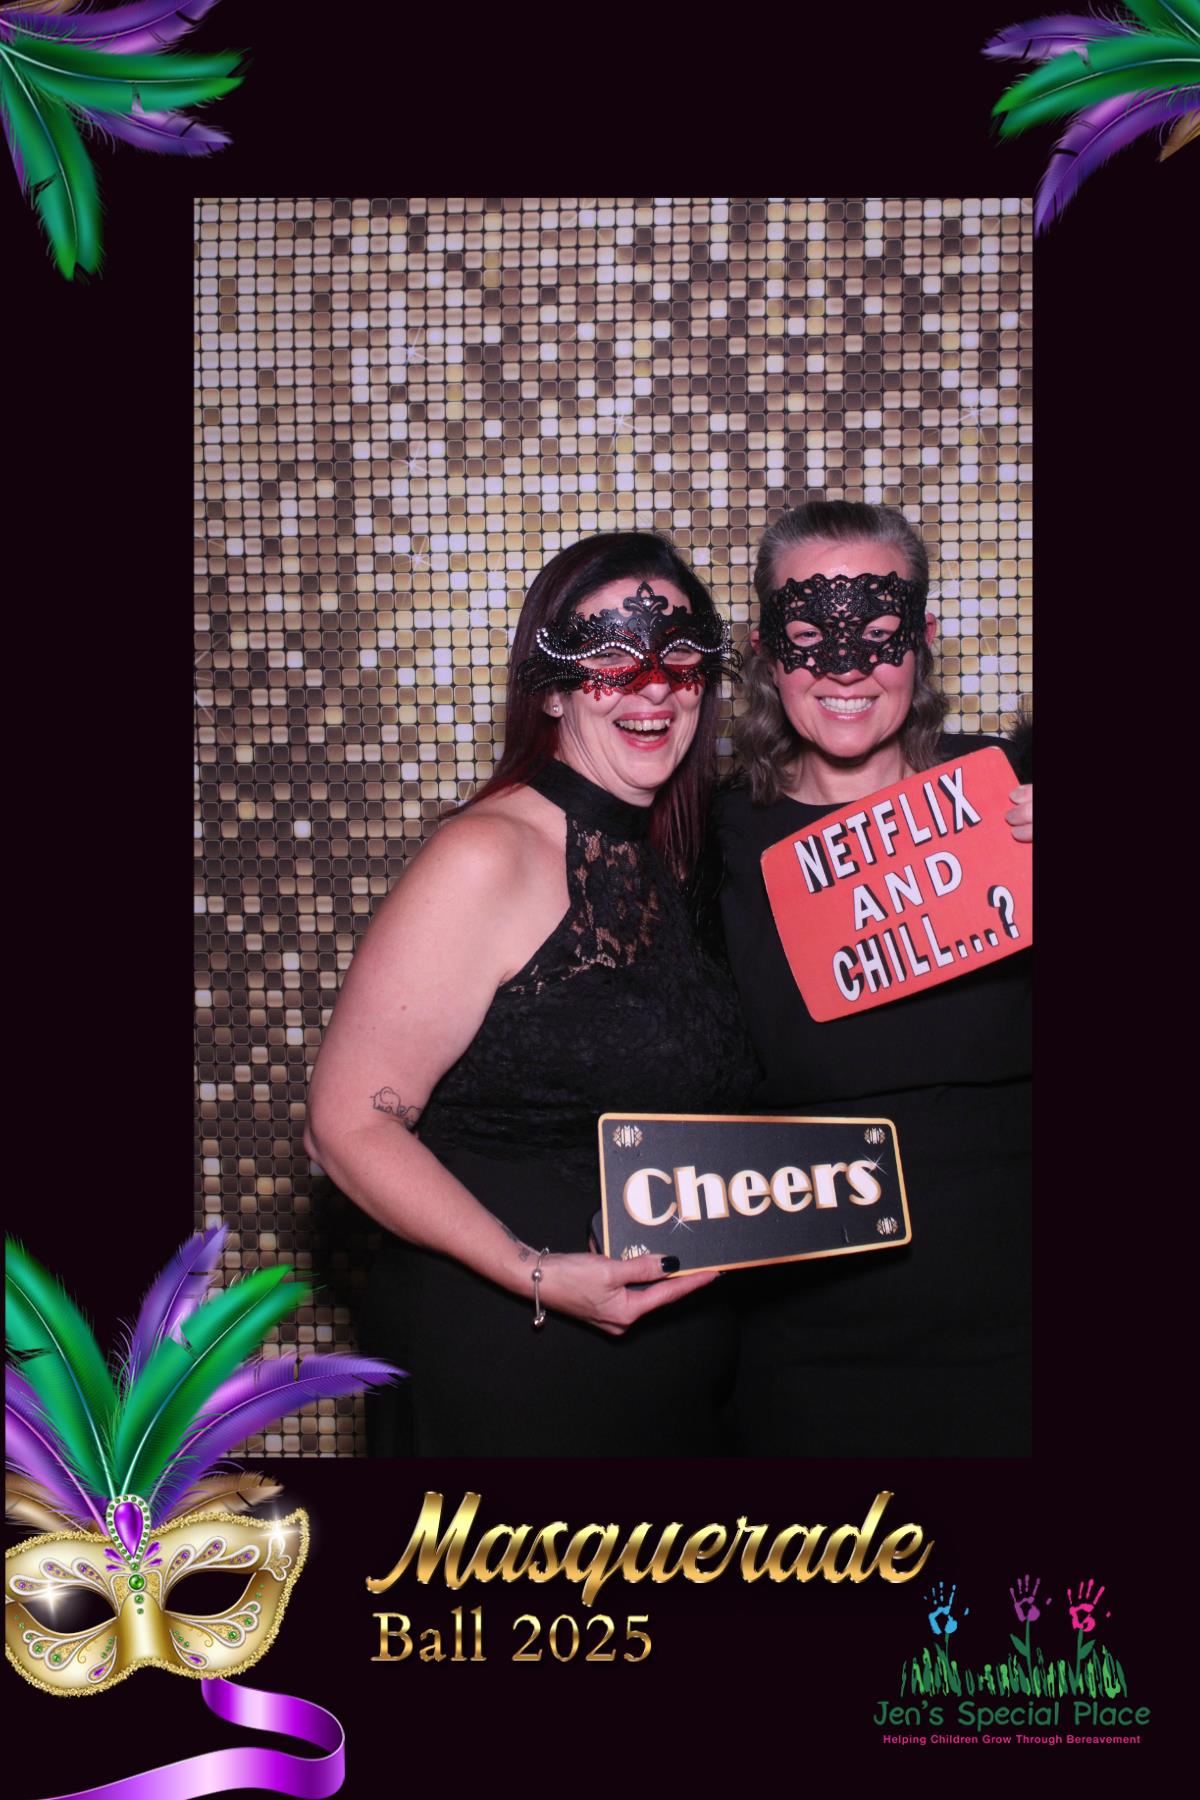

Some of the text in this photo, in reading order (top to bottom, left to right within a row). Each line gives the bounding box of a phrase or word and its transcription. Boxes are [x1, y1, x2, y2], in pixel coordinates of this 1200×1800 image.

[793, 767, 982, 894] NETFLIX
[853, 851, 963, 932] AND
[623, 1159, 882, 1226] Cheers
